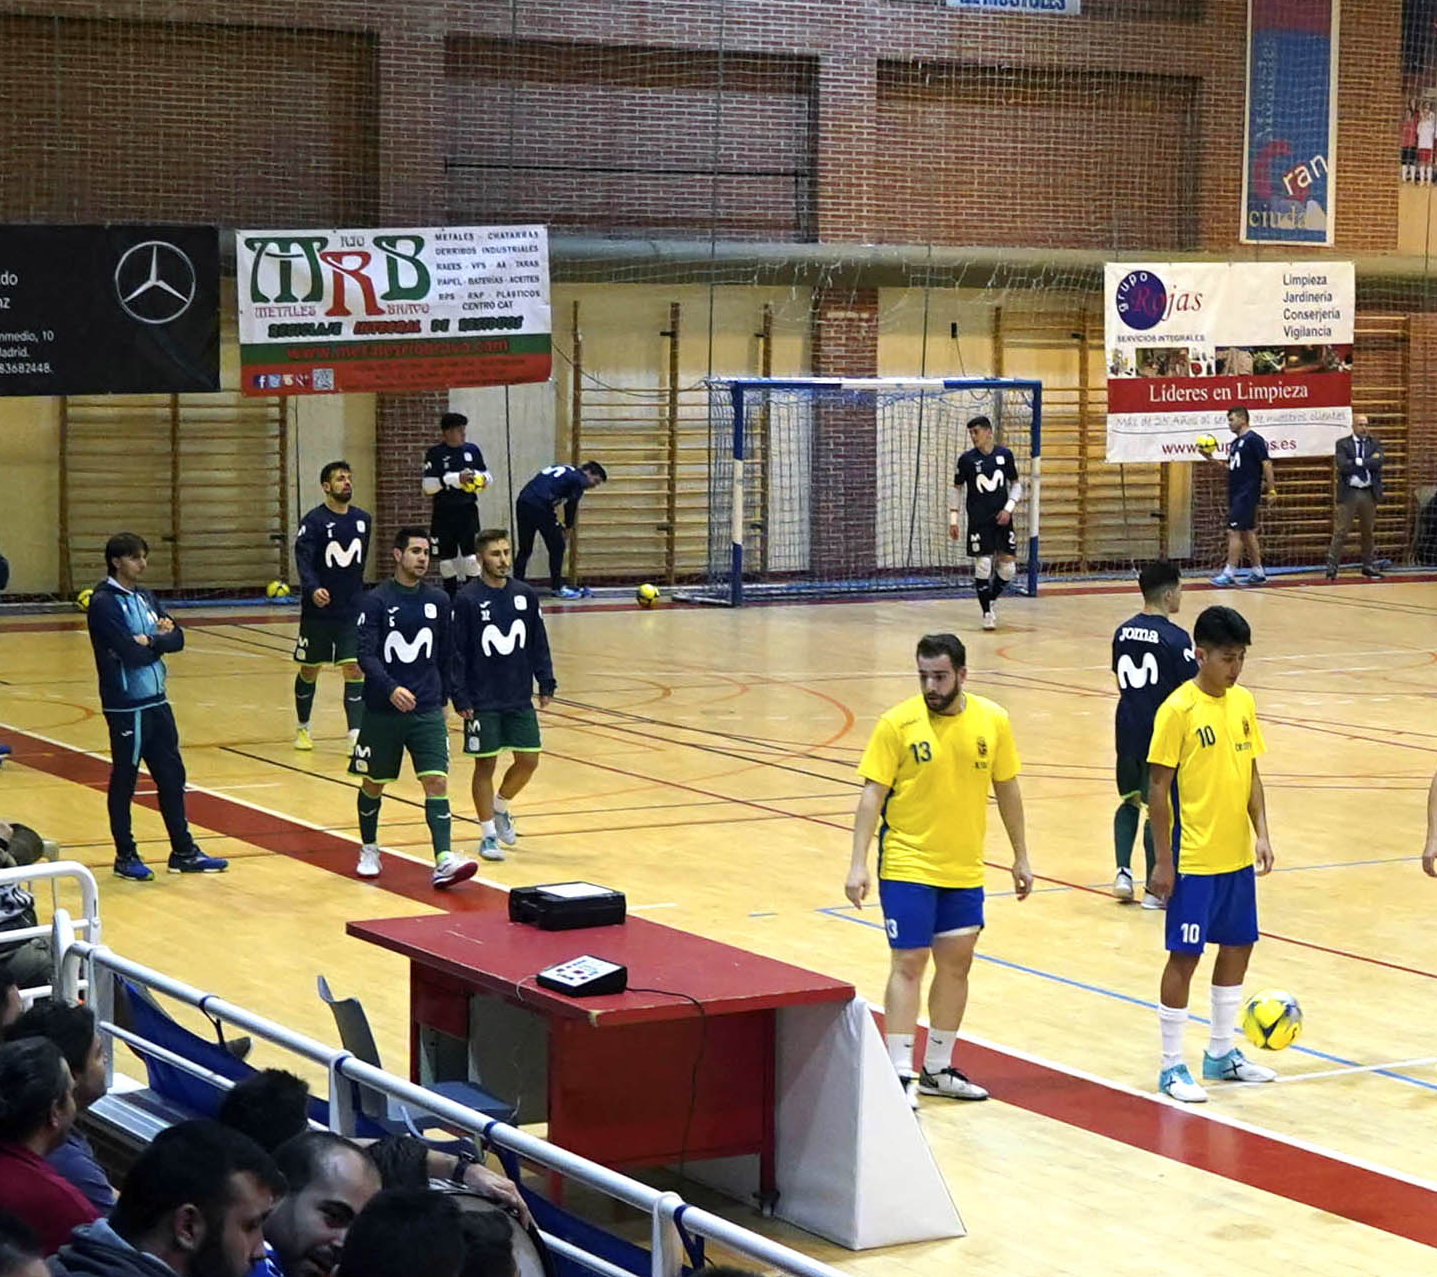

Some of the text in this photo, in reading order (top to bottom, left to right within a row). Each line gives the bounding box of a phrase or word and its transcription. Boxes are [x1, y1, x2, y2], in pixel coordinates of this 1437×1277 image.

[482, 245, 539, 254] INDUSTRIALES
[1283, 273, 1328, 287] Limpieza
[1118, 271, 1149, 313] grupo
[462, 300, 514, 310] CENTRO CAT
[1132, 284, 1204, 322] Rojas
[254, 305, 316, 318] METALES
[42, 329, 54, 342] 10
[1117, 334, 1205, 343] SERVICIOS INTEGRALES
[1283, 325, 1332, 339] Vigilancia
[1149, 380, 1309, 404] Líderes en Limpieza
[1196, 725, 1216, 748] 10
[910, 740, 932, 765] 13
[1180, 922, 1200, 944] 10
